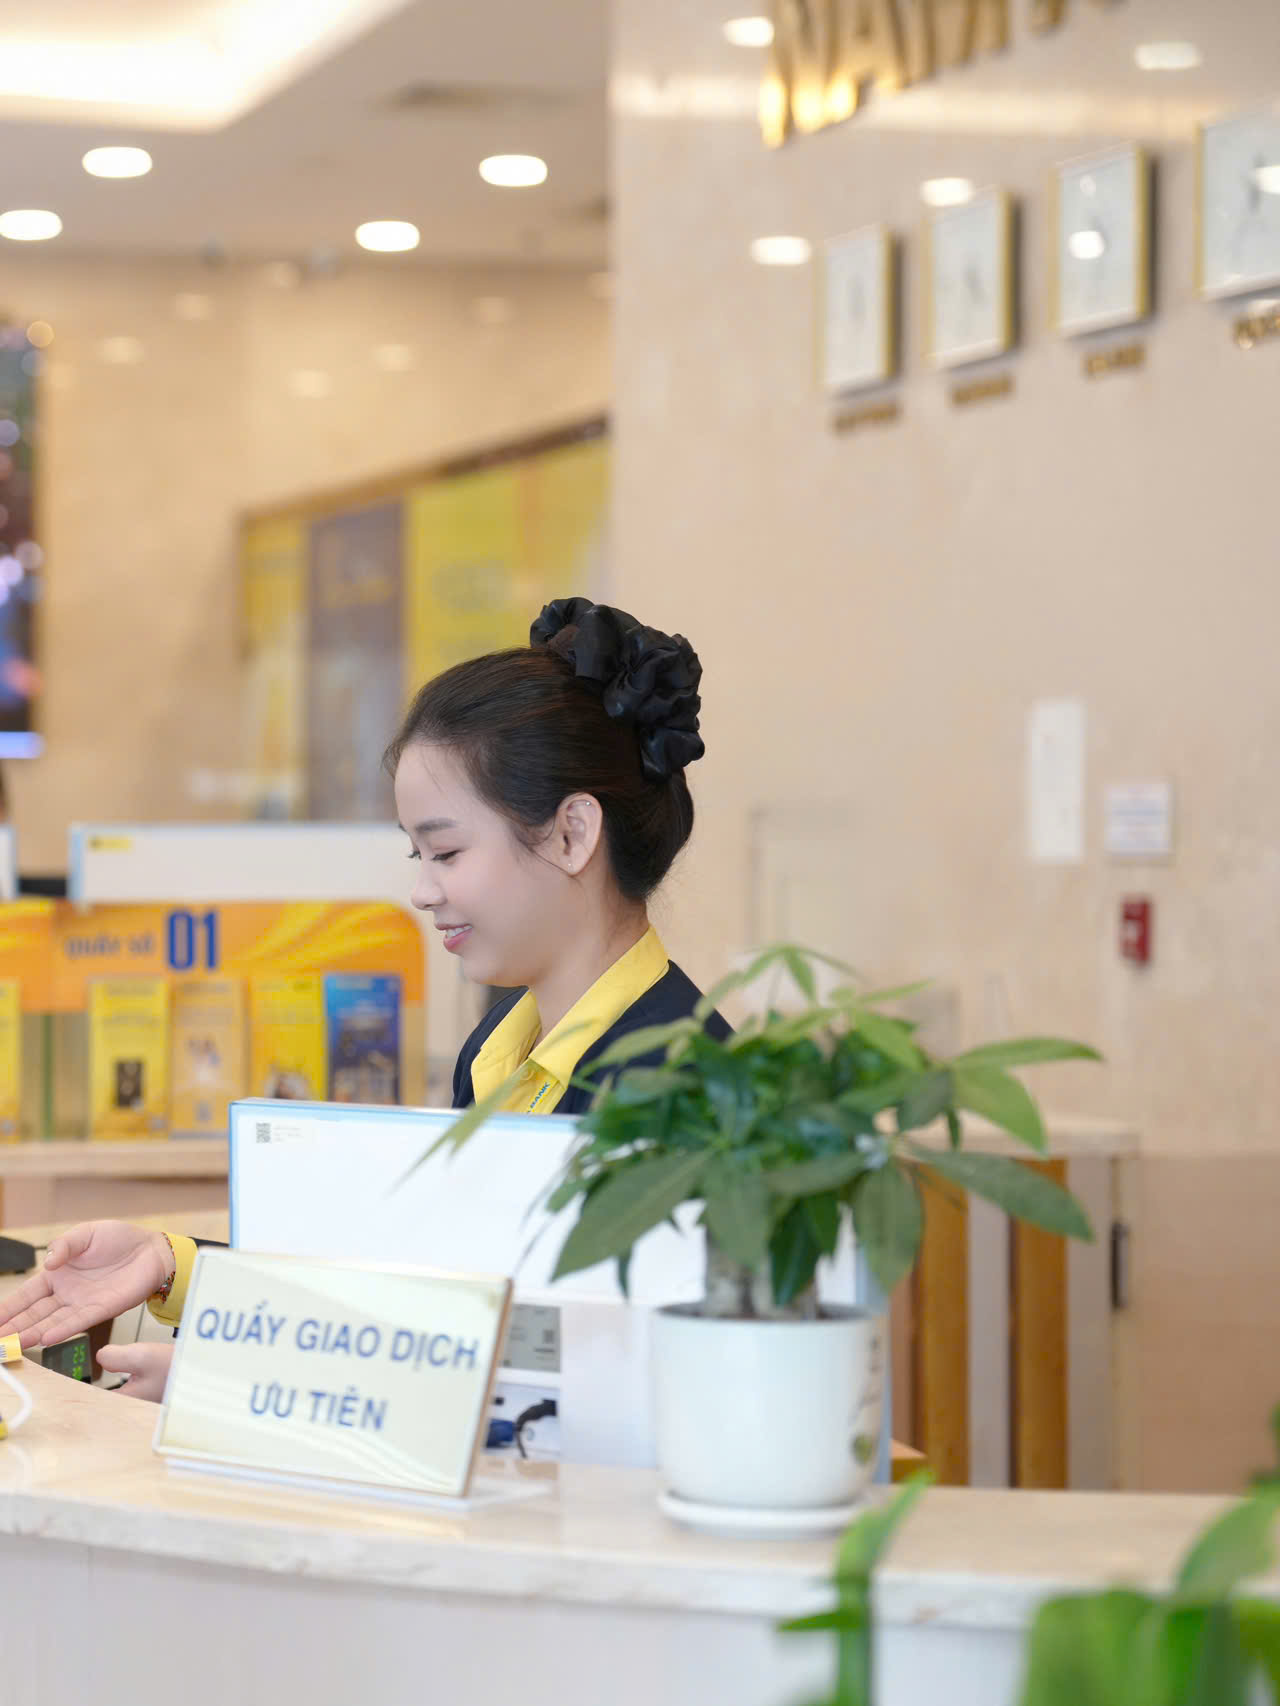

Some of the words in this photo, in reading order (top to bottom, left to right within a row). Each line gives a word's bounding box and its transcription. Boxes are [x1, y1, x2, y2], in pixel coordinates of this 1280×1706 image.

[166, 909, 219, 970] 01
[295, 1318, 382, 1358] GIAO
[389, 1328, 480, 1372] DỊCH
[308, 1384, 388, 1430] TIÊN
